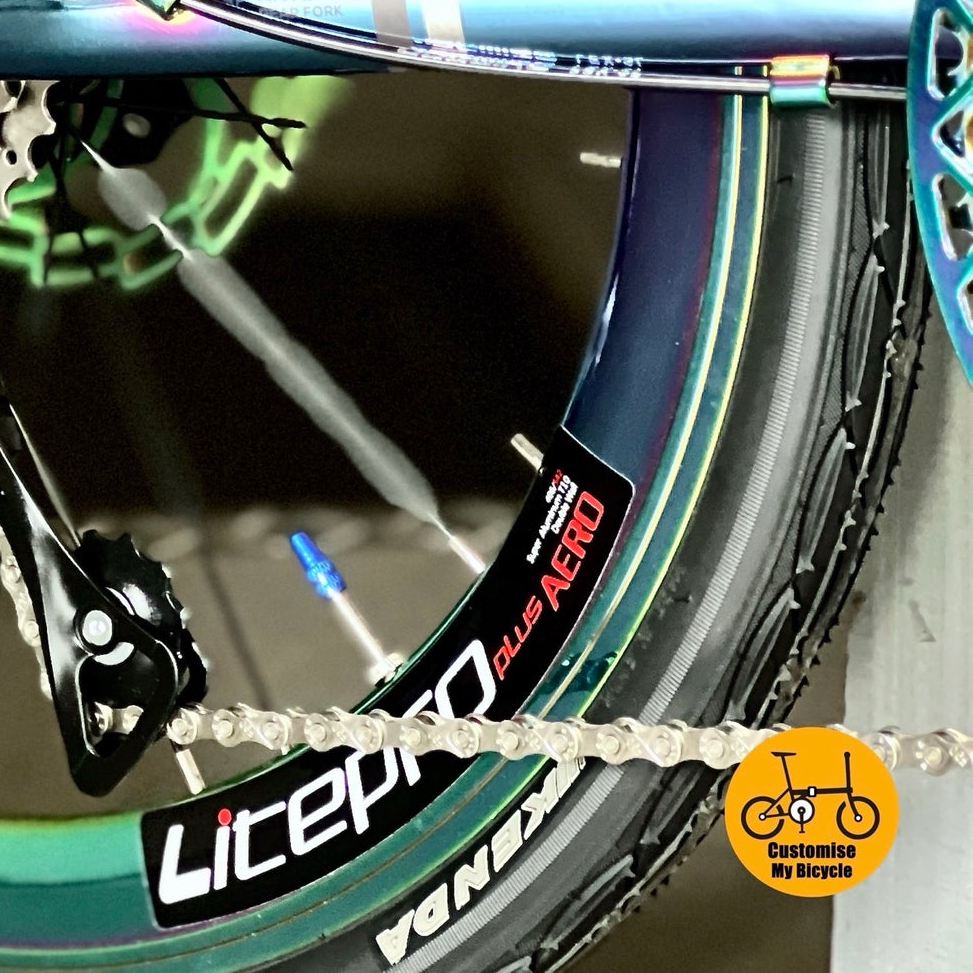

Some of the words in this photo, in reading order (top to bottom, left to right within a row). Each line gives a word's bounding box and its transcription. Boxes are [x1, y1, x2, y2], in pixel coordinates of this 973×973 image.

[302, 5, 343, 18] FORK
[526, 538, 542, 564] Super
[538, 494, 563, 539] Aluminum
[541, 491, 605, 612] AERO
[375, 763, 565, 966] KENDA
